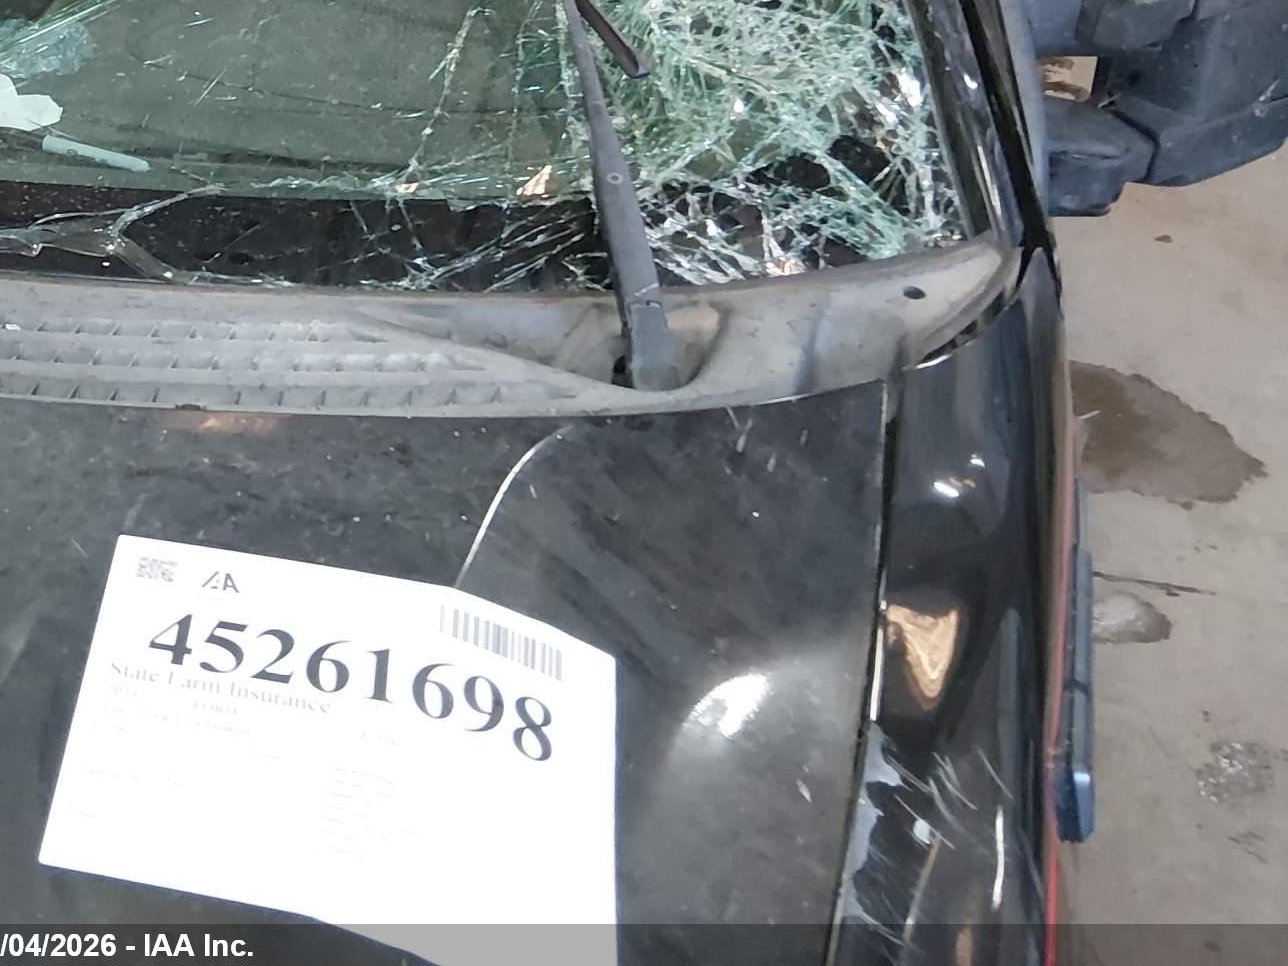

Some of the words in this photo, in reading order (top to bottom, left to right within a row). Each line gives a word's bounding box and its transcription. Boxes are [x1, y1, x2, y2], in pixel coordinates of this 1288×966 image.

[110, 662, 161, 684] State
[230, 681, 331, 715] Insurance
[149, 613, 553, 762] 45261698
